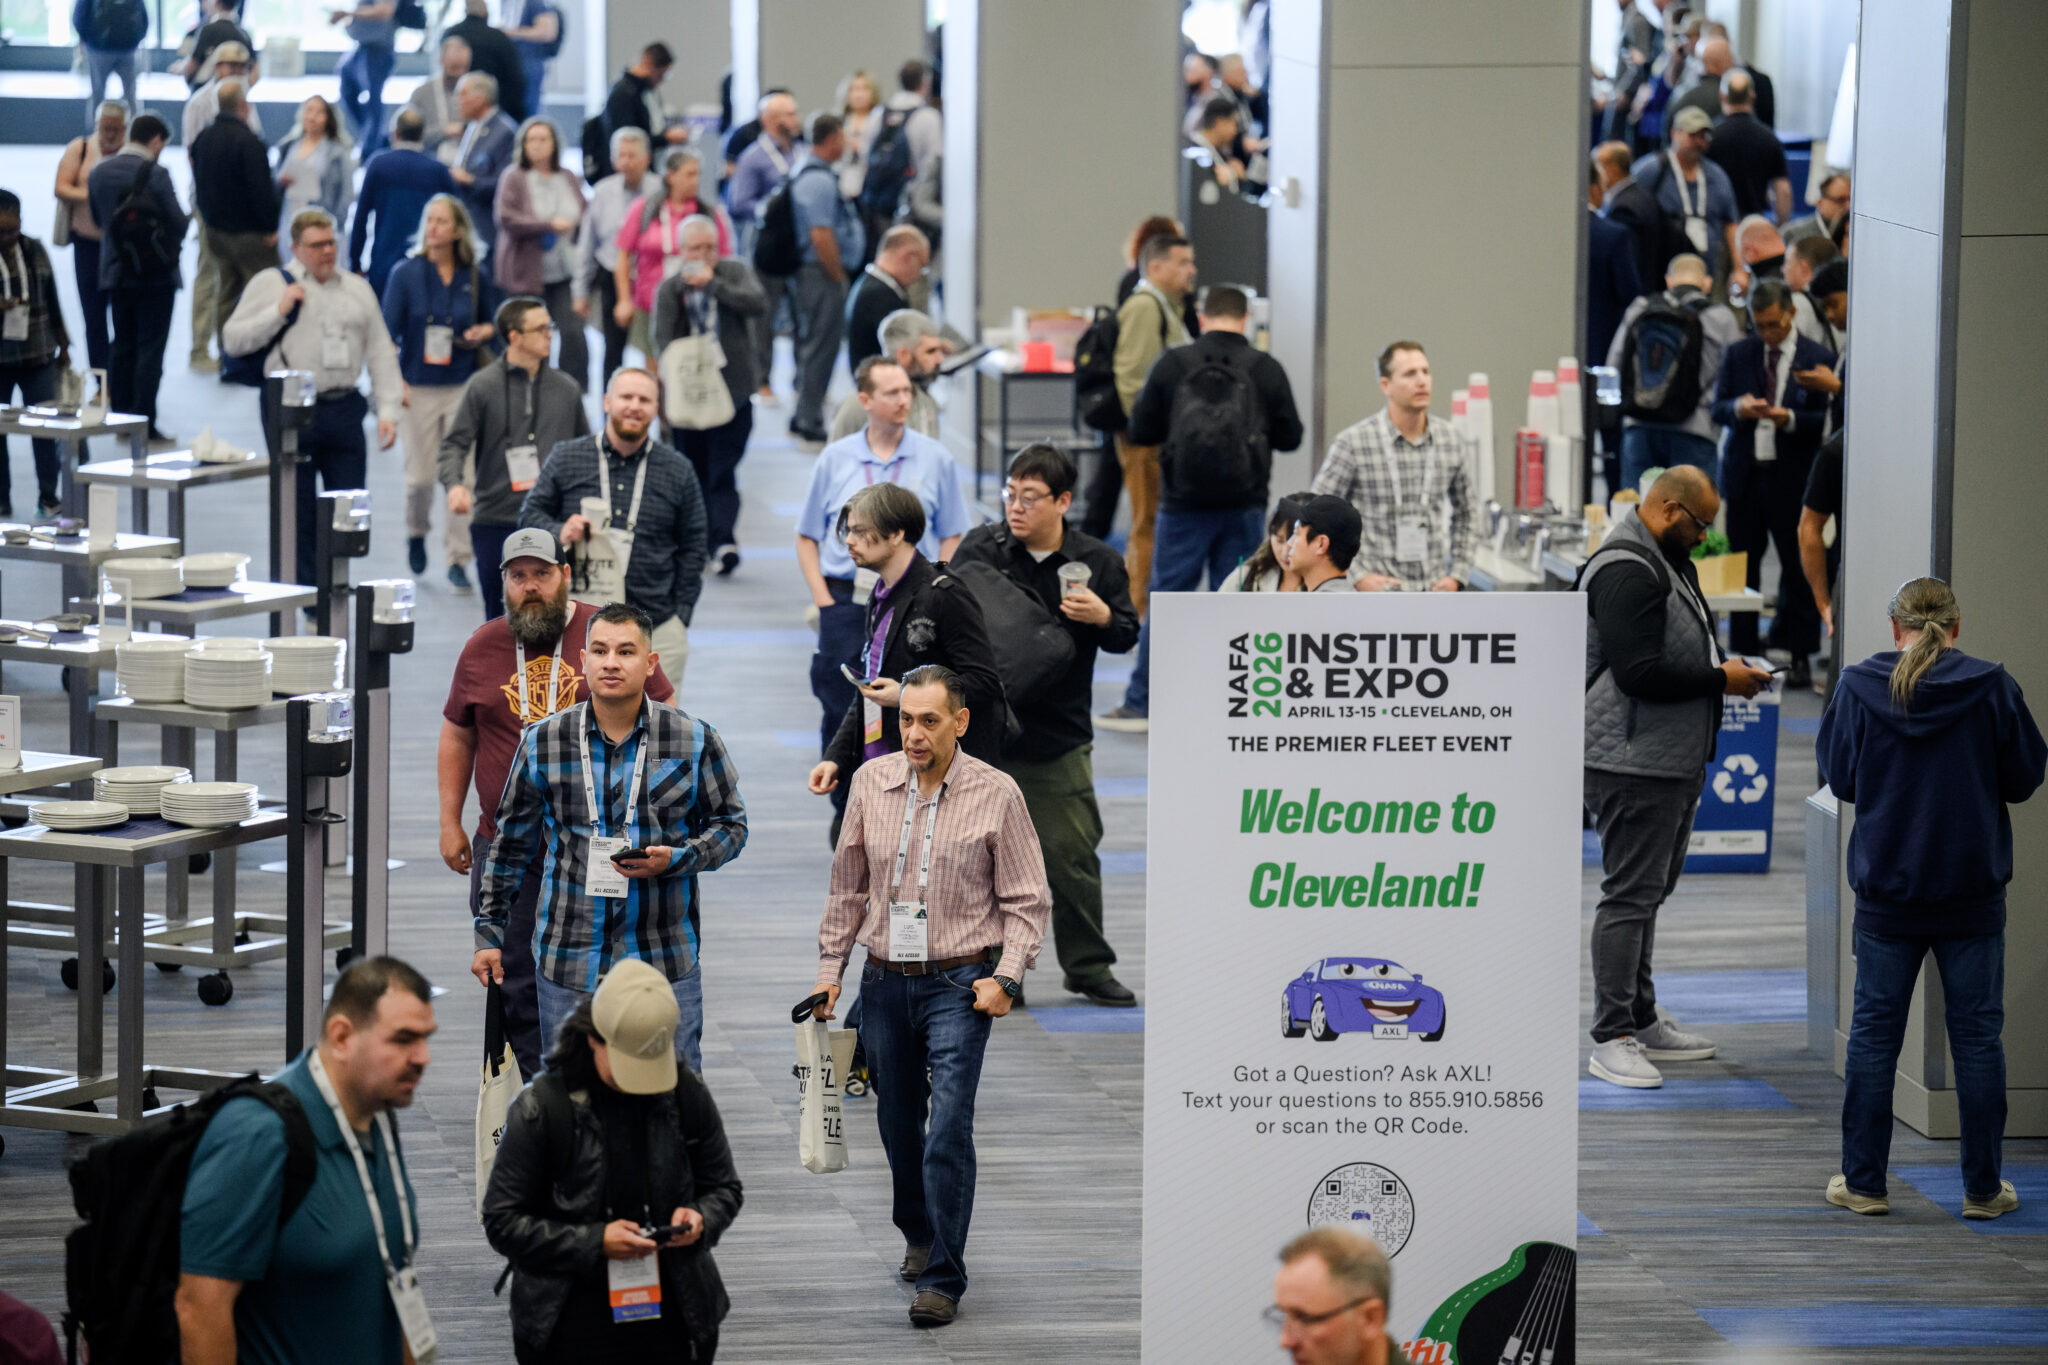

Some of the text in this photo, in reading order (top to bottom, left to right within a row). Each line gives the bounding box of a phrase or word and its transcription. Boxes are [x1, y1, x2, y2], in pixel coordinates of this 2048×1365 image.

[1287, 633, 1516, 664] INSTITUTE
[1228, 632, 1249, 718] NAFA
[1252, 632, 1283, 718] 2026
[1285, 667, 1449, 699] & EXPO
[1287, 705, 1512, 720] APRIL 13-15 CLEVELAND, OH
[1228, 736, 1512, 752] THE PREMIER FLEET EVENT
[1240, 788, 1496, 834] Welcome to
[1248, 861, 1485, 909] Cleveland!
[1382, 1027, 1401, 1036] AXL
[1233, 1065, 1491, 1084] Got a Question? Ask AXL!
[1182, 1091, 1543, 1112] Text your questions to 855.910.5856
[1256, 1117, 1468, 1136] or scan the QR Code.
